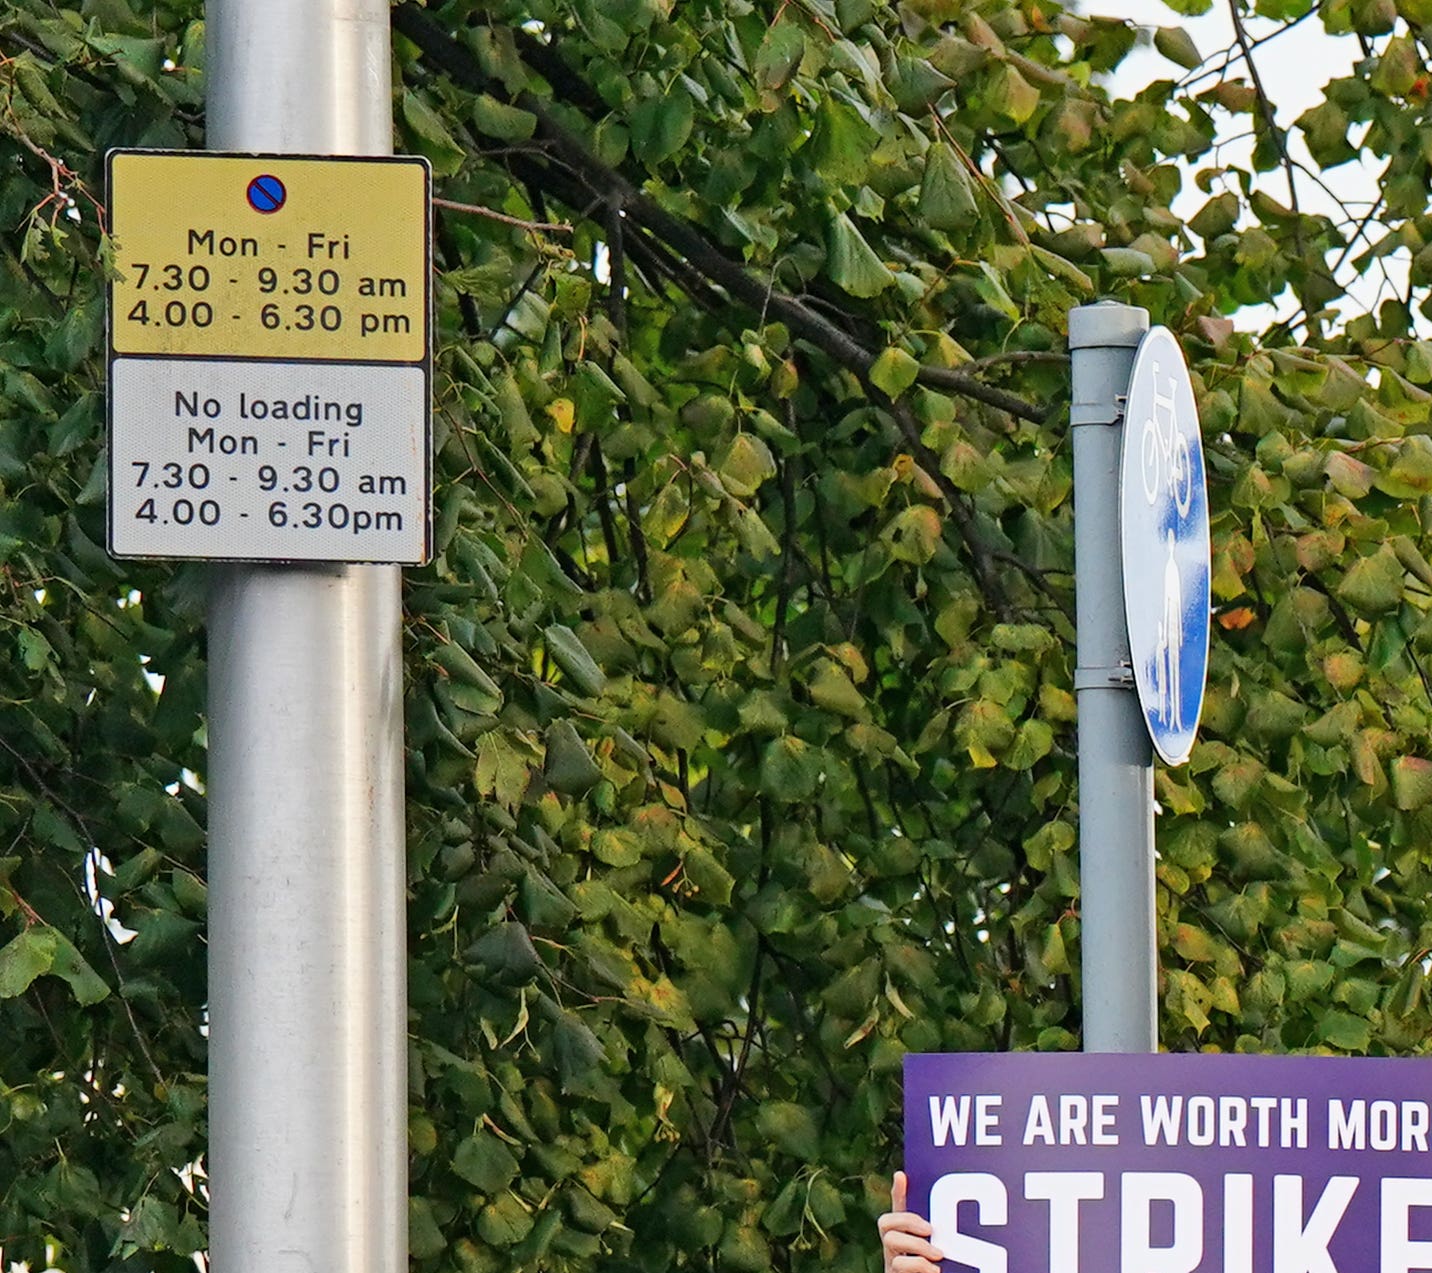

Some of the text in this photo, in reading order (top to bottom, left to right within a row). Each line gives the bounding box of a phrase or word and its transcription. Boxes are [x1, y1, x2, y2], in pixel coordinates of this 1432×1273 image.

[189, 229, 257, 256] Mon
[308, 233, 349, 259] Fri
[132, 264, 209, 291] 7.30
[258, 268, 339, 295] 9.30
[358, 276, 406, 296] am
[128, 300, 212, 327] 4.00
[261, 304, 341, 331] 6.30
[361, 312, 410, 338] pm
[176, 391, 362, 427] No loading
[189, 427, 257, 454] Mon
[309, 431, 349, 457] Fri
[132, 462, 209, 489] 7.30
[259, 465, 339, 493] 9.30
[359, 475, 405, 494] am
[136, 499, 220, 525] 4.00
[930, 1096, 1002, 1146] WE
[1023, 1095, 1118, 1144] ARE
[1141, 1096, 1307, 1148] WORTH
